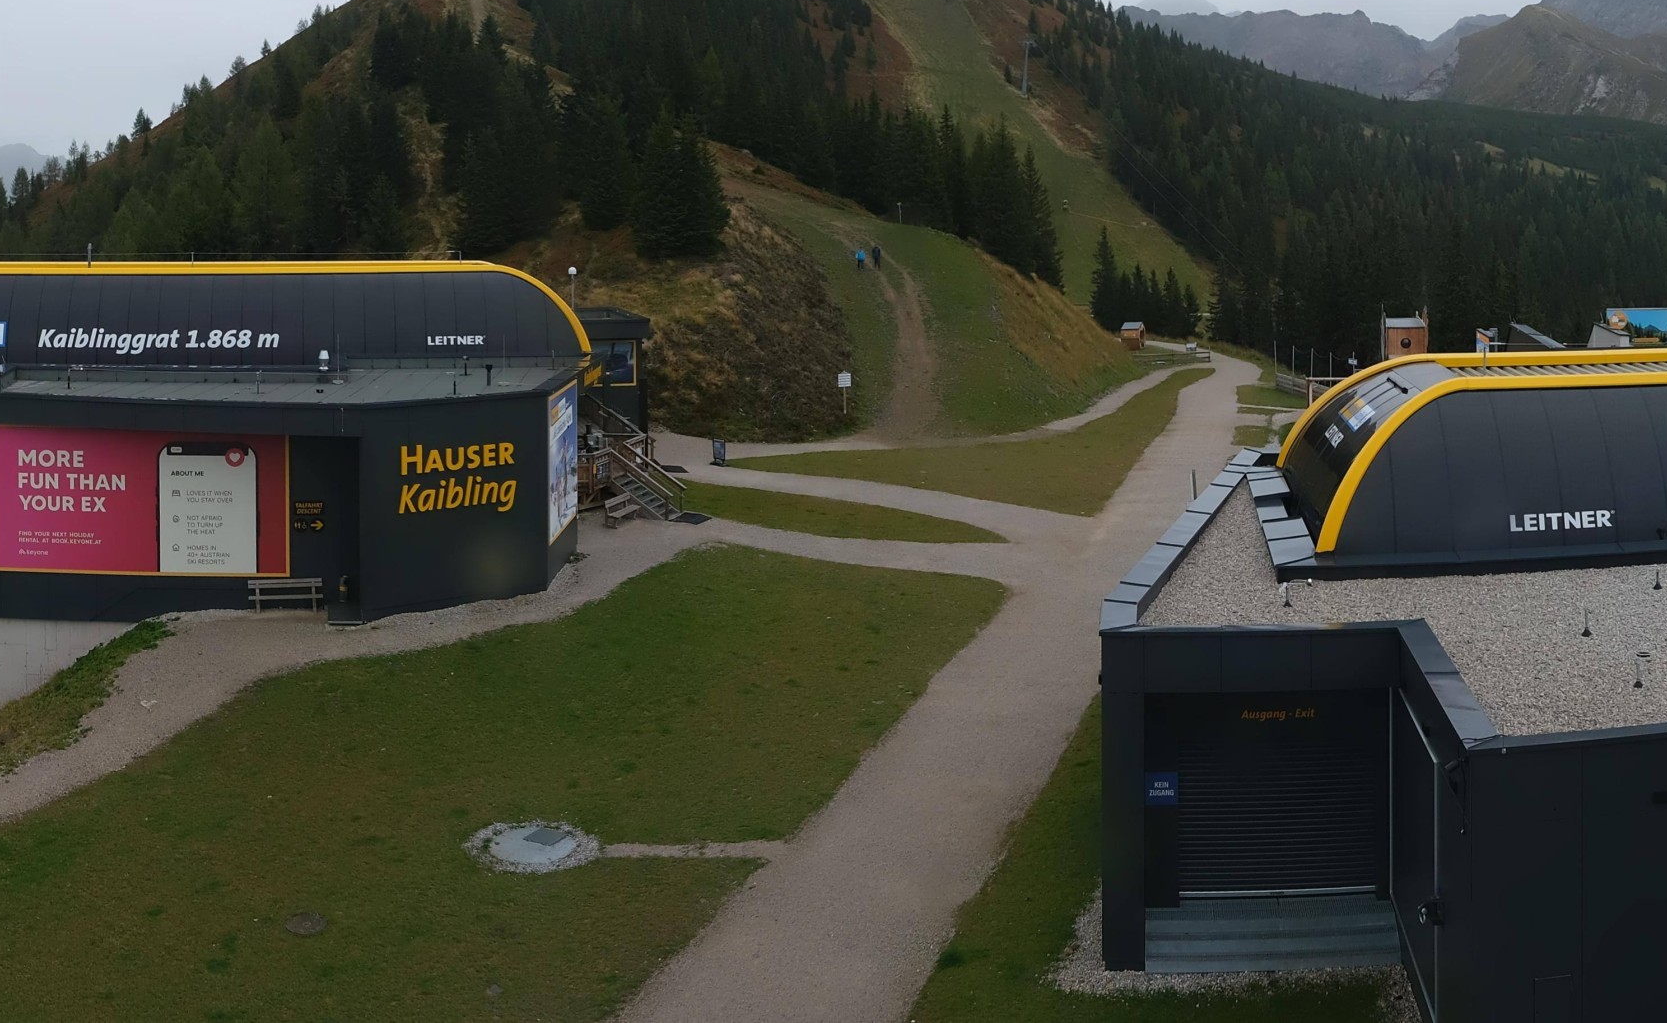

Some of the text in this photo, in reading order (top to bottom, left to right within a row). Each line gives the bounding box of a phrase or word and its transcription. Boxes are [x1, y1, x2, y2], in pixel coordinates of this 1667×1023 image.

[38, 328, 280, 355] Kaiblinggrat 1.868 m
[427, 335, 485, 346] LEITNER
[18, 449, 84, 467] MORE
[401, 442, 515, 476] HAUSER
[18, 472, 126, 491] FUN THAN
[19, 495, 107, 512] YOUR EX
[398, 476, 517, 514] Kaibling
[1509, 510, 1613, 532] LEITNER
[26, 549, 49, 557] keyone
[1241, 710, 1286, 721] Ausgang
[1295, 708, 1315, 718] Exit
